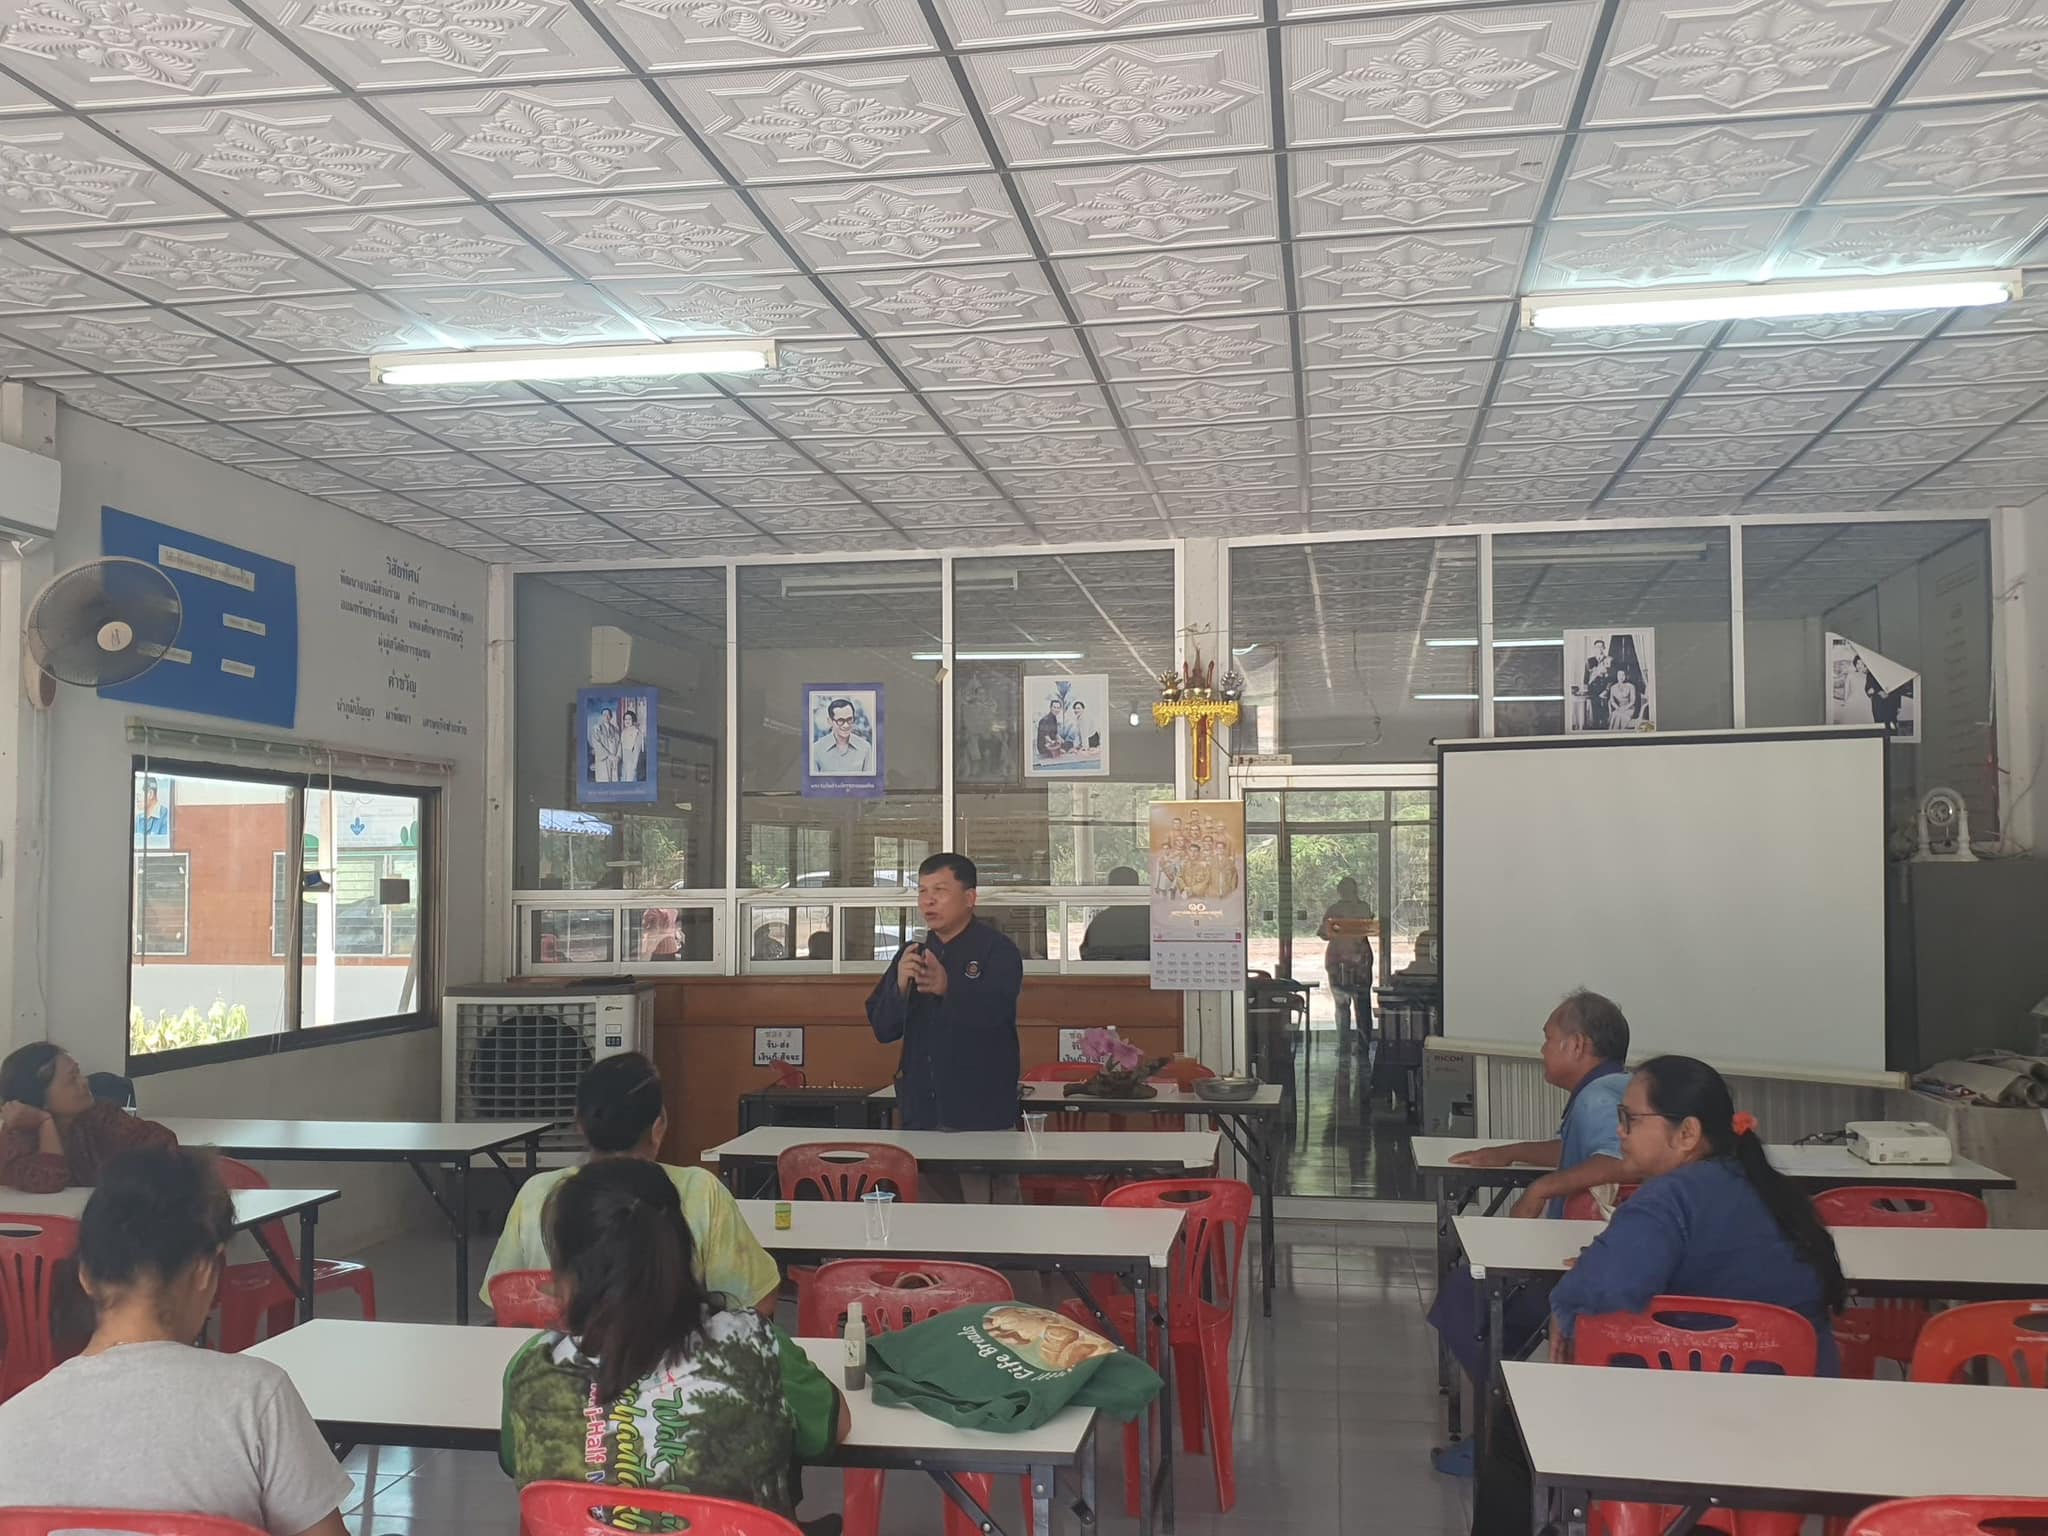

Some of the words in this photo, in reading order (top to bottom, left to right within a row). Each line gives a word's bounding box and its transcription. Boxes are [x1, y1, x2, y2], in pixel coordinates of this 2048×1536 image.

[386, 555, 422, 584] วิสัยทัศน์
[388, 668, 417, 699] คำขวัญ
